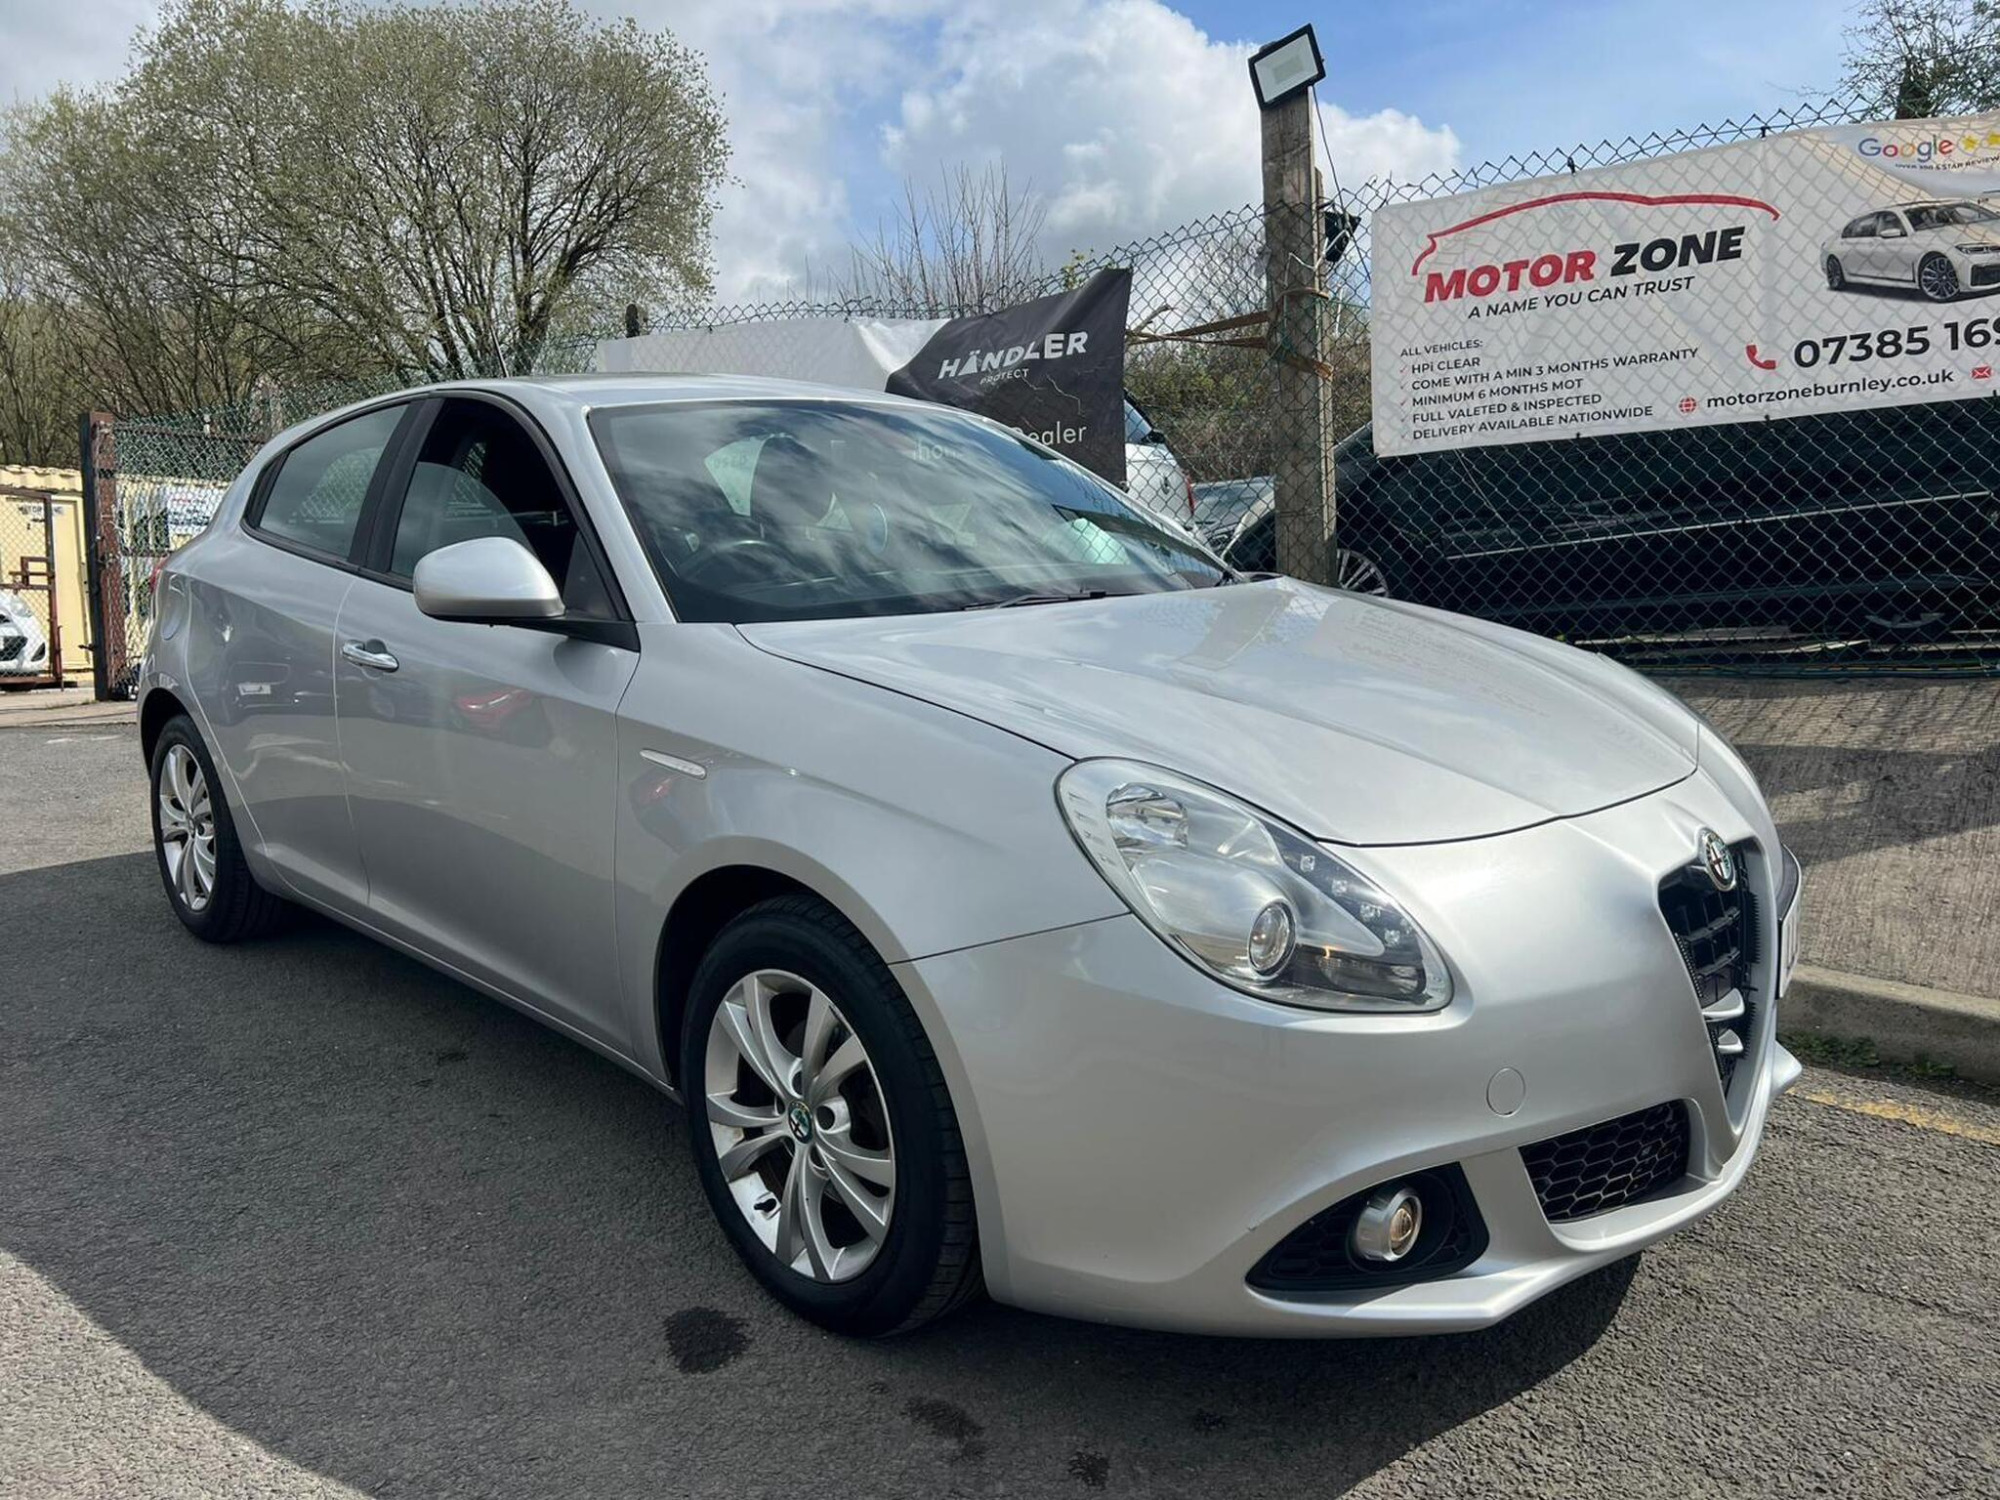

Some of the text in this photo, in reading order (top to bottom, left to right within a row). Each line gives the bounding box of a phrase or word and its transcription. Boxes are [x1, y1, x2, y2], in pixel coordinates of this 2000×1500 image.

[1858, 134, 1953, 163] Google
[1423, 226, 1745, 303] MOTOR ZONE
[1468, 276, 1695, 319] A NAME YOU CAN TRUST
[938, 331, 1088, 380] HÄNDLER
[1400, 339, 1483, 357] ALL VEHICLES:
[1794, 316, 2000, 368] 07385 16
[980, 368, 1030, 385] PROTECT
[1412, 347, 1698, 391] COME WITH A MIN 3 MONTHS WARRANTY
[1437, 357, 1481, 371] CLEAR
[1412, 378, 1583, 407] MINIMUM 6 MONTHS MOT
[1707, 369, 1954, 408] motorzoneburnley.co.uk
[1413, 394, 1602, 424] FULL VALETED & INSPECTED
[1413, 406, 1653, 440] DELIVERY AVAILABLE NATIONWIDE
[1010, 420, 1087, 446] ealer
